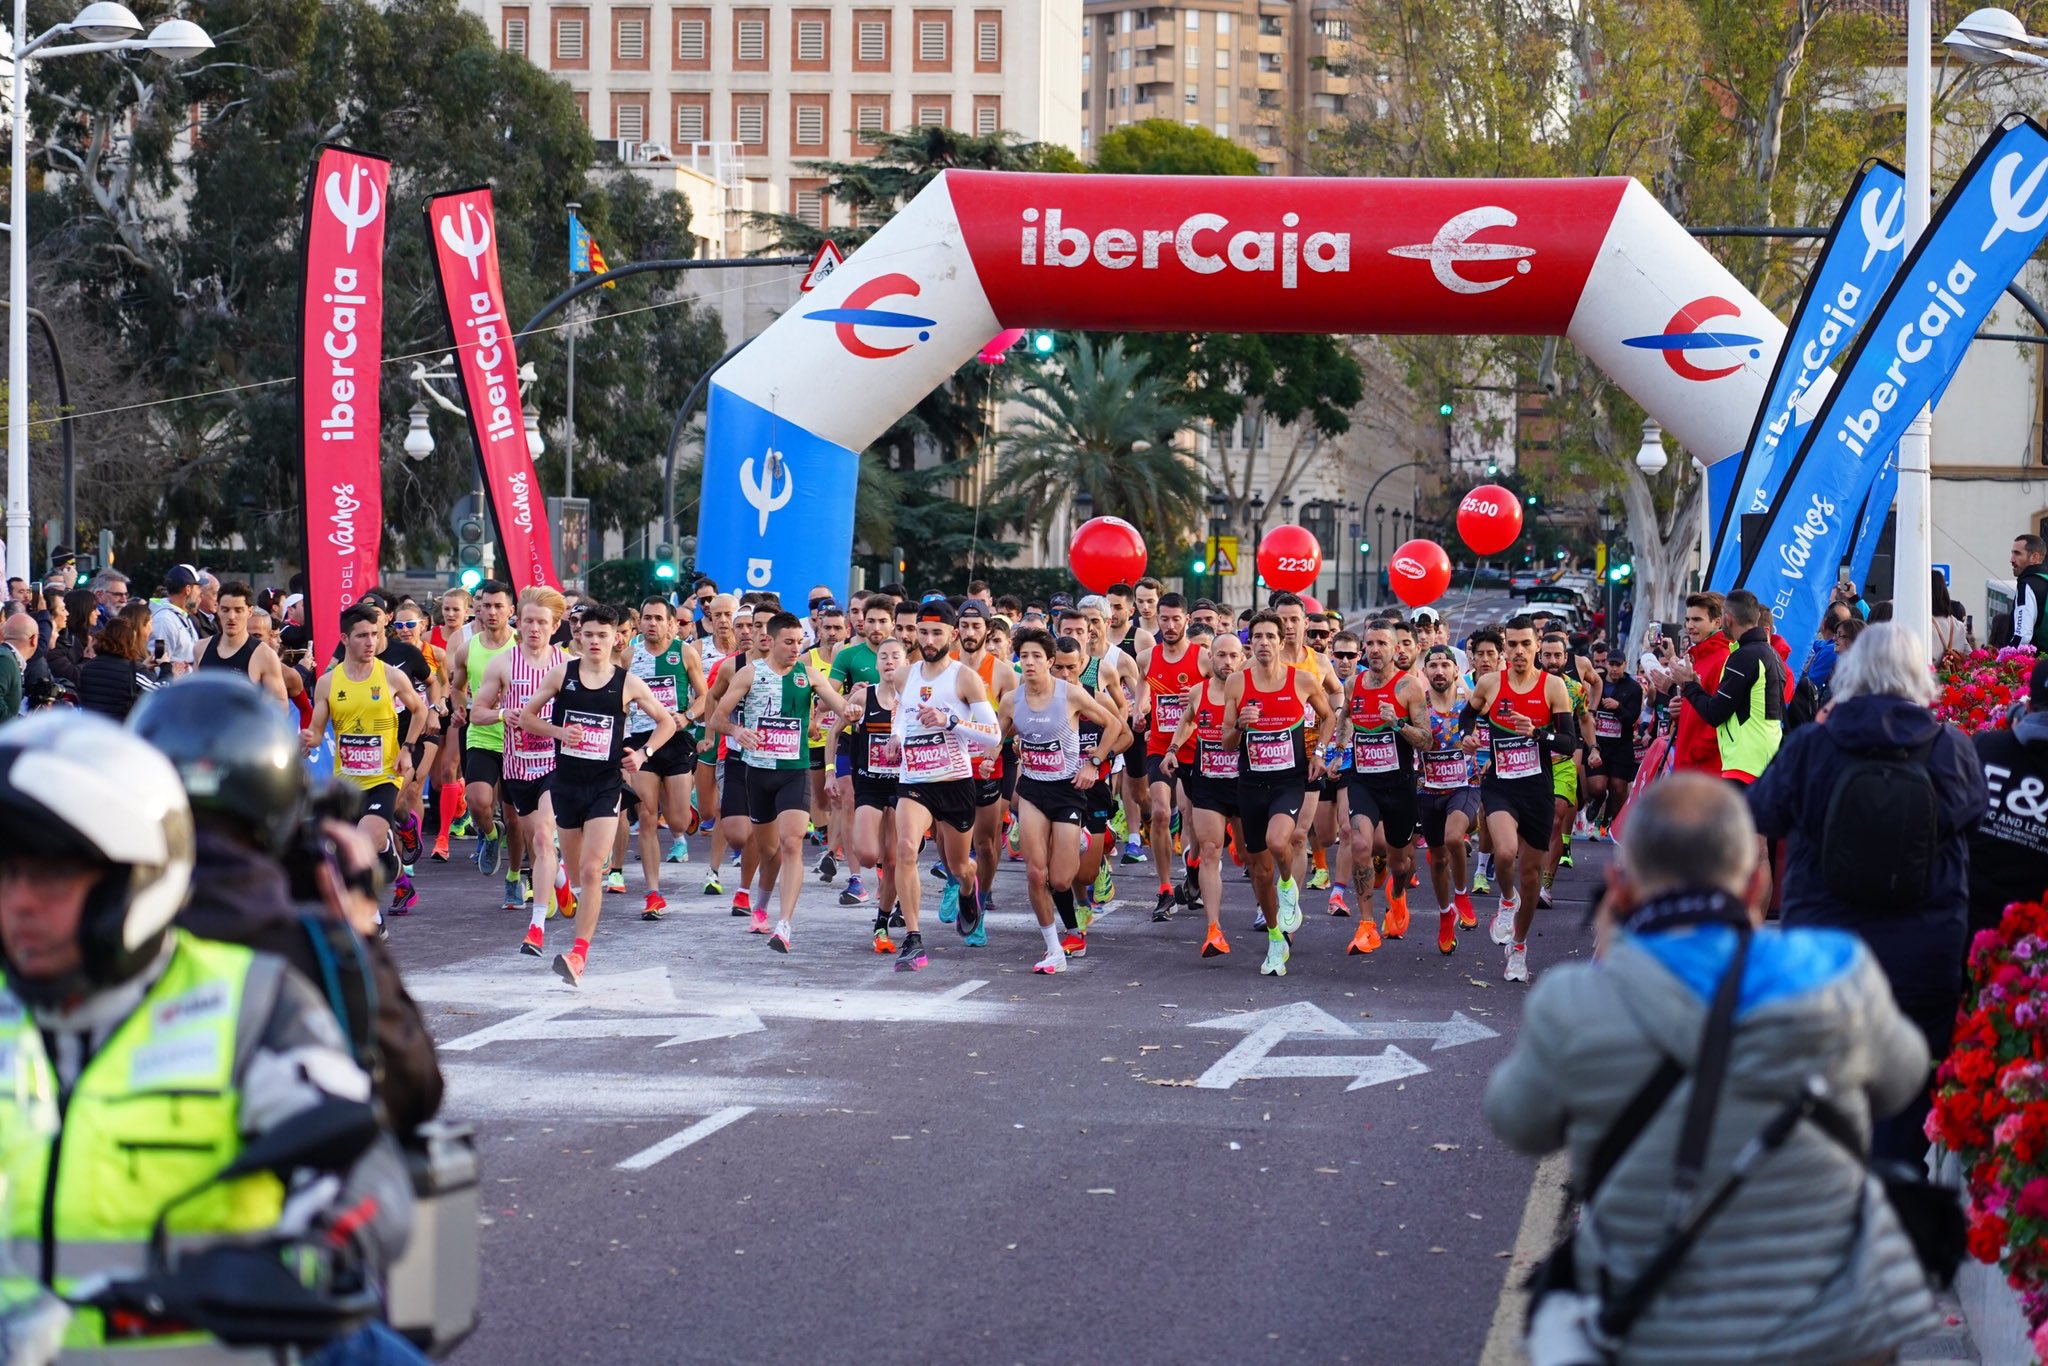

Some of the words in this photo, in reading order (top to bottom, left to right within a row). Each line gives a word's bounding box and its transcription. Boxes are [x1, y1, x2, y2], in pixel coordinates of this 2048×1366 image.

[1021, 207, 1350, 289] iberCaja
[320, 267, 366, 441] iberCaja
[1837, 258, 1978, 457] iberCaja
[466, 291, 515, 442] iberCaja
[1764, 281, 1863, 448] iberCaja
[508, 471, 533, 533] Vamos
[1461, 498, 1498, 517] 25:00
[328, 482, 360, 555] Vamos
[1779, 493, 1835, 580] Vamos
[1277, 556, 1316, 572] 22:30
[341, 561, 354, 588] DEL
[1771, 586, 1794, 620] DEL
[652, 689, 674, 701] 0123
[581, 729, 610, 746] 0005
[767, 732, 798, 746] 20009
[1080, 733, 1098, 742] JECT
[347, 749, 381, 763] 20038
[915, 747, 948, 763] 20024
[1031, 754, 1061, 766] 21420
[1260, 744, 1290, 759] 20017
[1364, 746, 1394, 760] 20013
[1507, 750, 1536, 765] 20016
[1998, 812, 2024, 830] AND
[2024, 820, 2048, 840] LEG
